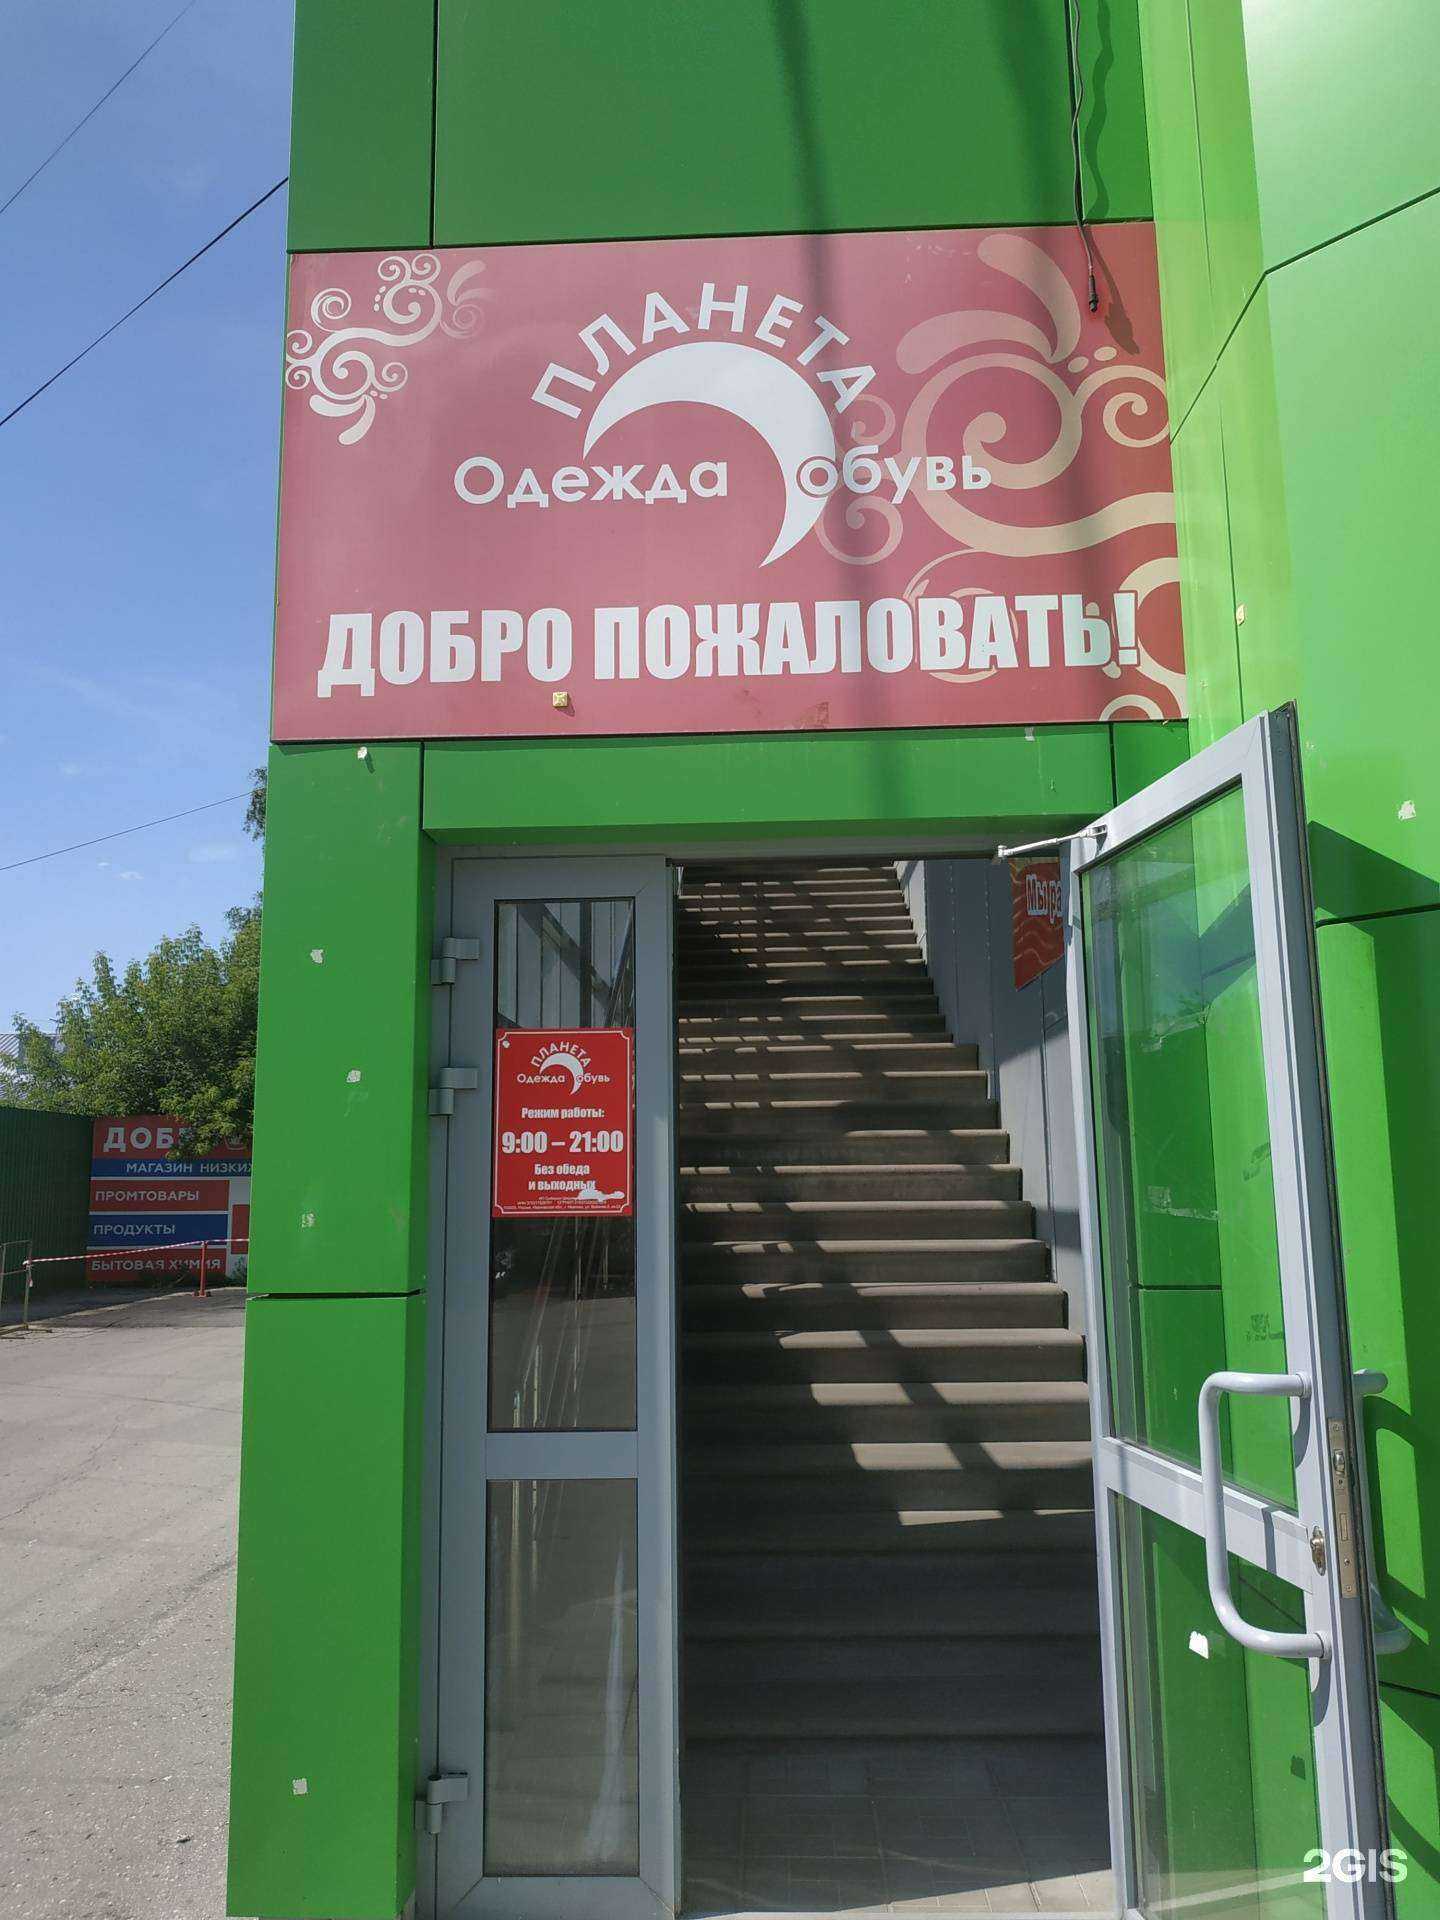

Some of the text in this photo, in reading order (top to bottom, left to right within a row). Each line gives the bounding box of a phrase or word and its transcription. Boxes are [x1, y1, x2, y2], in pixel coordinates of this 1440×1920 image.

[531, 282, 878, 418] ПЛАНЕТА
[454, 456, 729, 509] Одежда
[316, 591, 1141, 698] ДОБРО ПОЖАЛОВАТЬ!
[530, 1041, 592, 1068] ПЛАНЕТА
[517, 1073, 566, 1084] Одежда
[521, 1107, 605, 1120] Режим работы:
[501, 1131, 548, 1154] 9:00
[569, 1130, 624, 1153] 21:00
[126, 1162, 193, 1173] МАГАЗИН
[534, 1163, 590, 1176] Без обеда
[538, 1180, 597, 1193] выходных
[95, 1190, 200, 1202] ПРОМТОВАРЫ
[93, 1224, 175, 1236] ПРОДУКТЫ
[91, 1260, 165, 1271] БЫТОВАЯ
